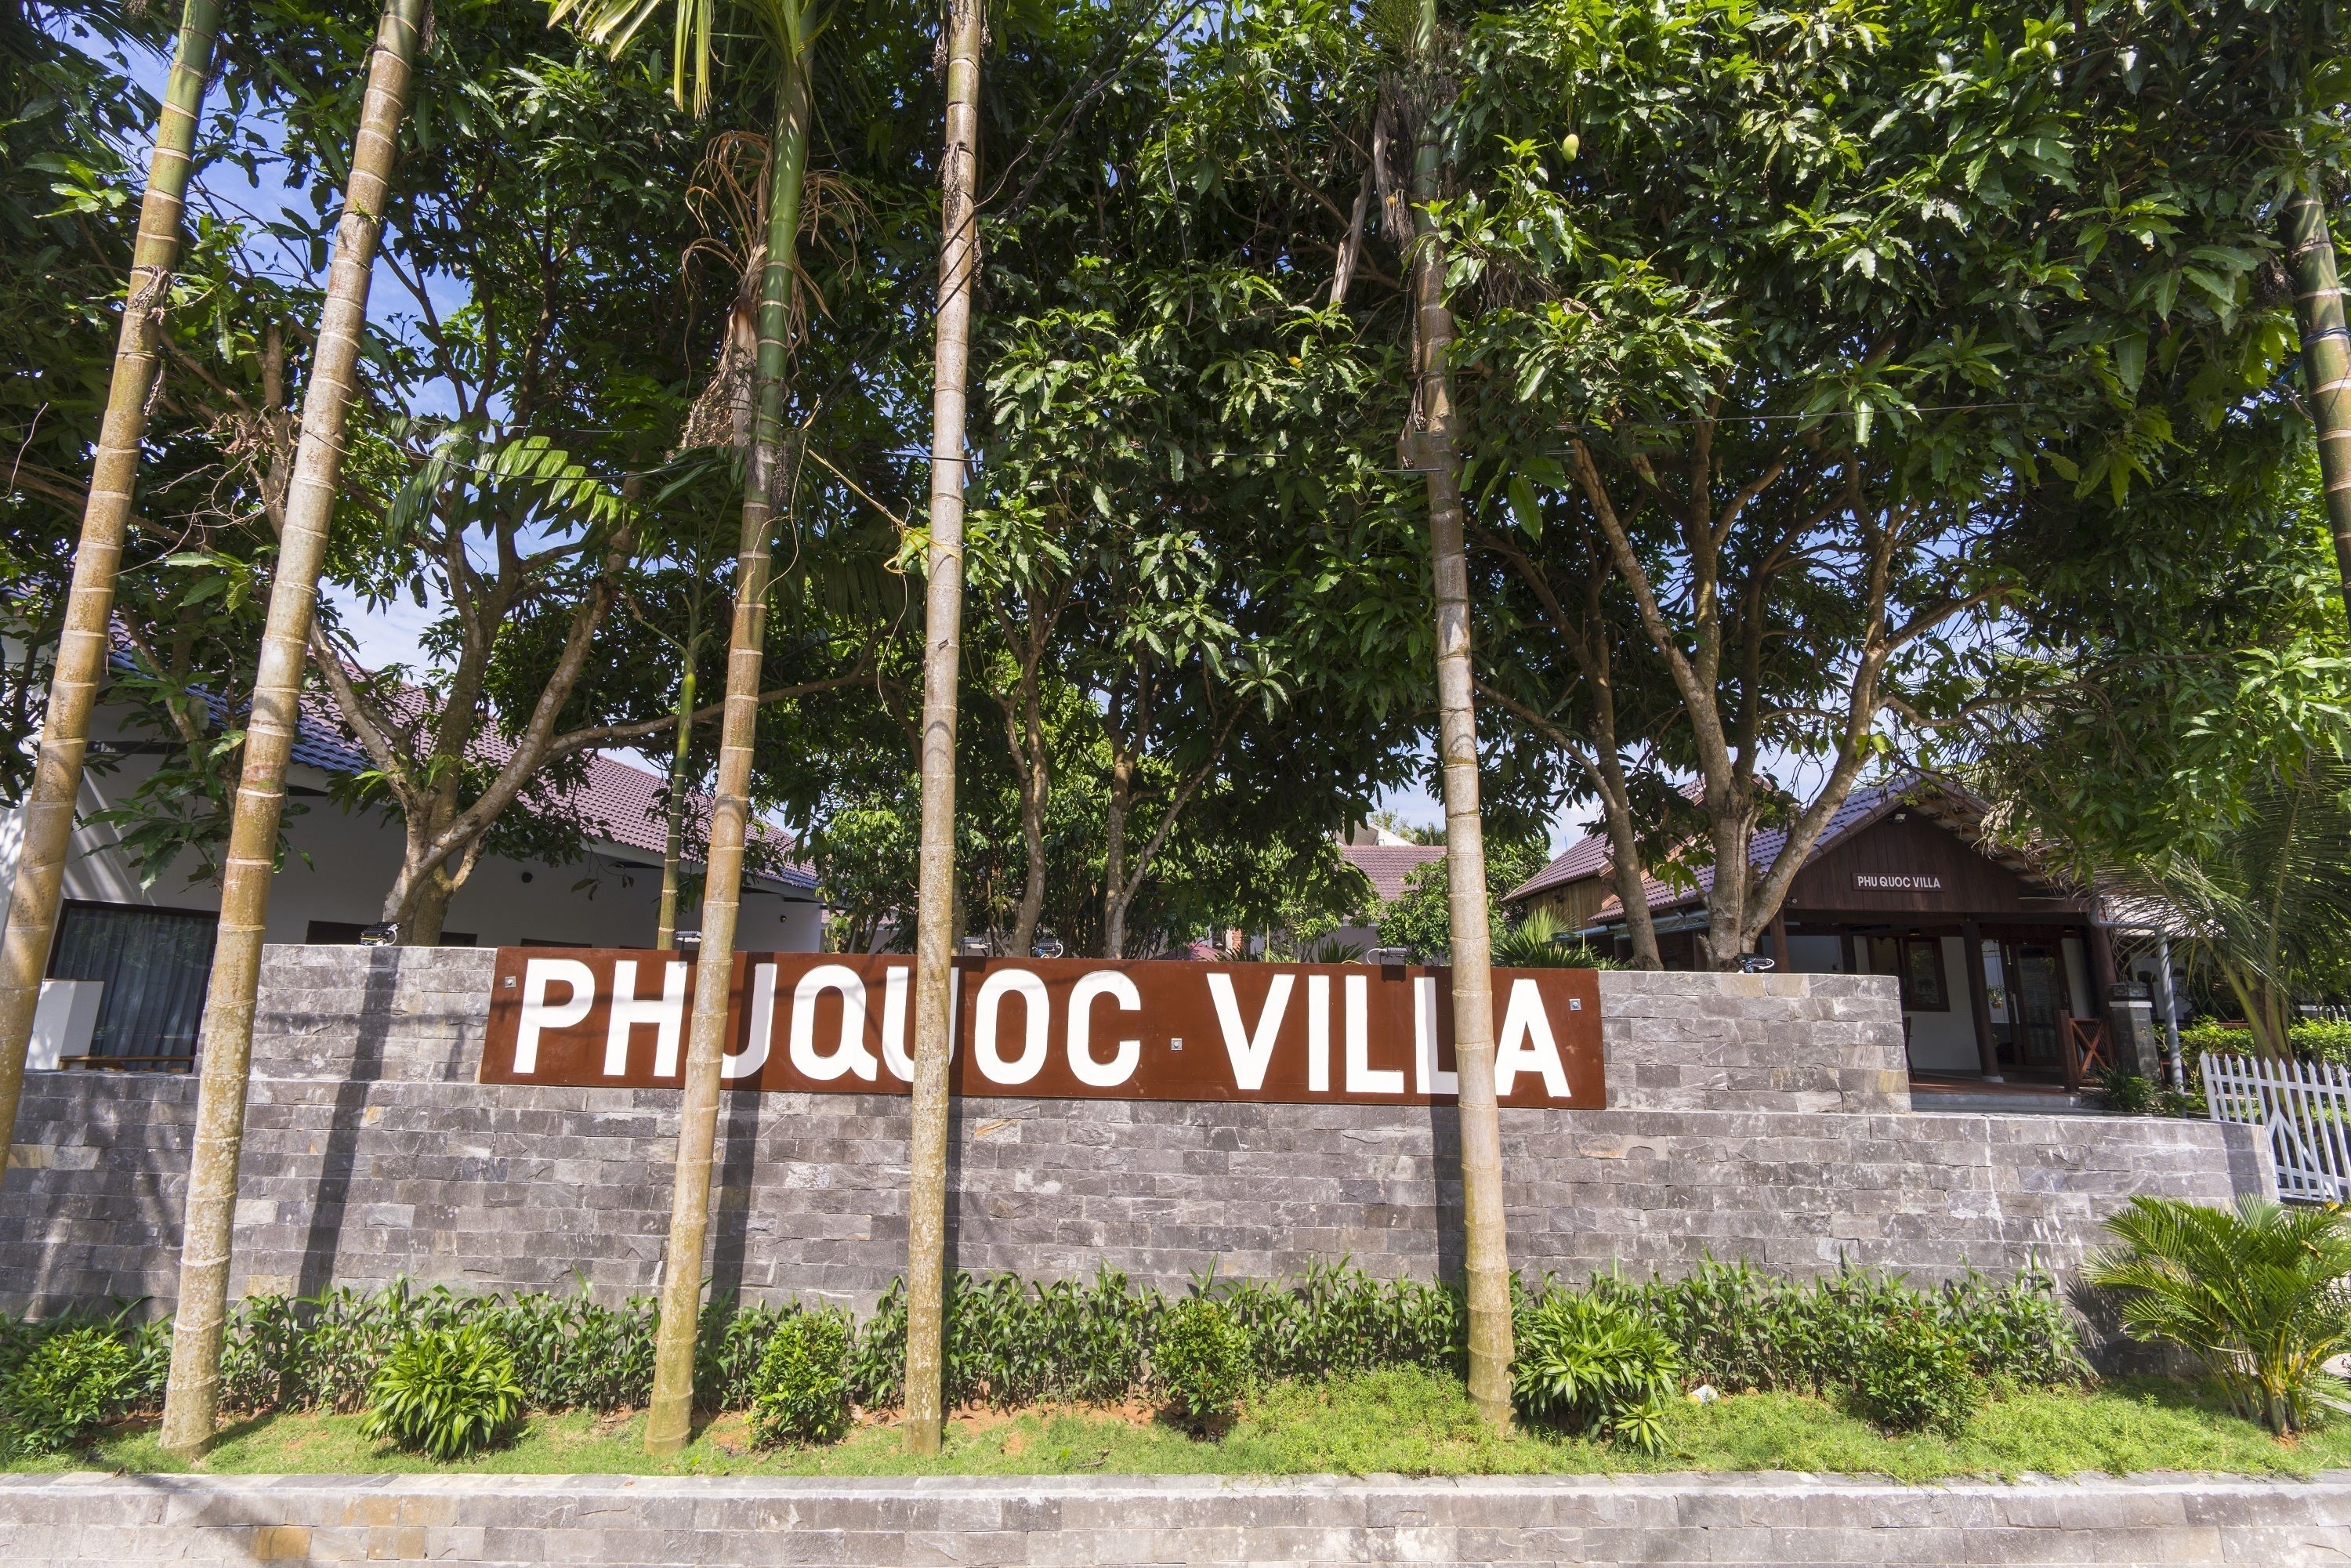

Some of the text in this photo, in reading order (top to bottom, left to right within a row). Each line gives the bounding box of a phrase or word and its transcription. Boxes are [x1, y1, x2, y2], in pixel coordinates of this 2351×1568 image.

[1857, 875, 1941, 888] PHU QUOC VILLA
[1206, 972, 1572, 1098] VILLA
